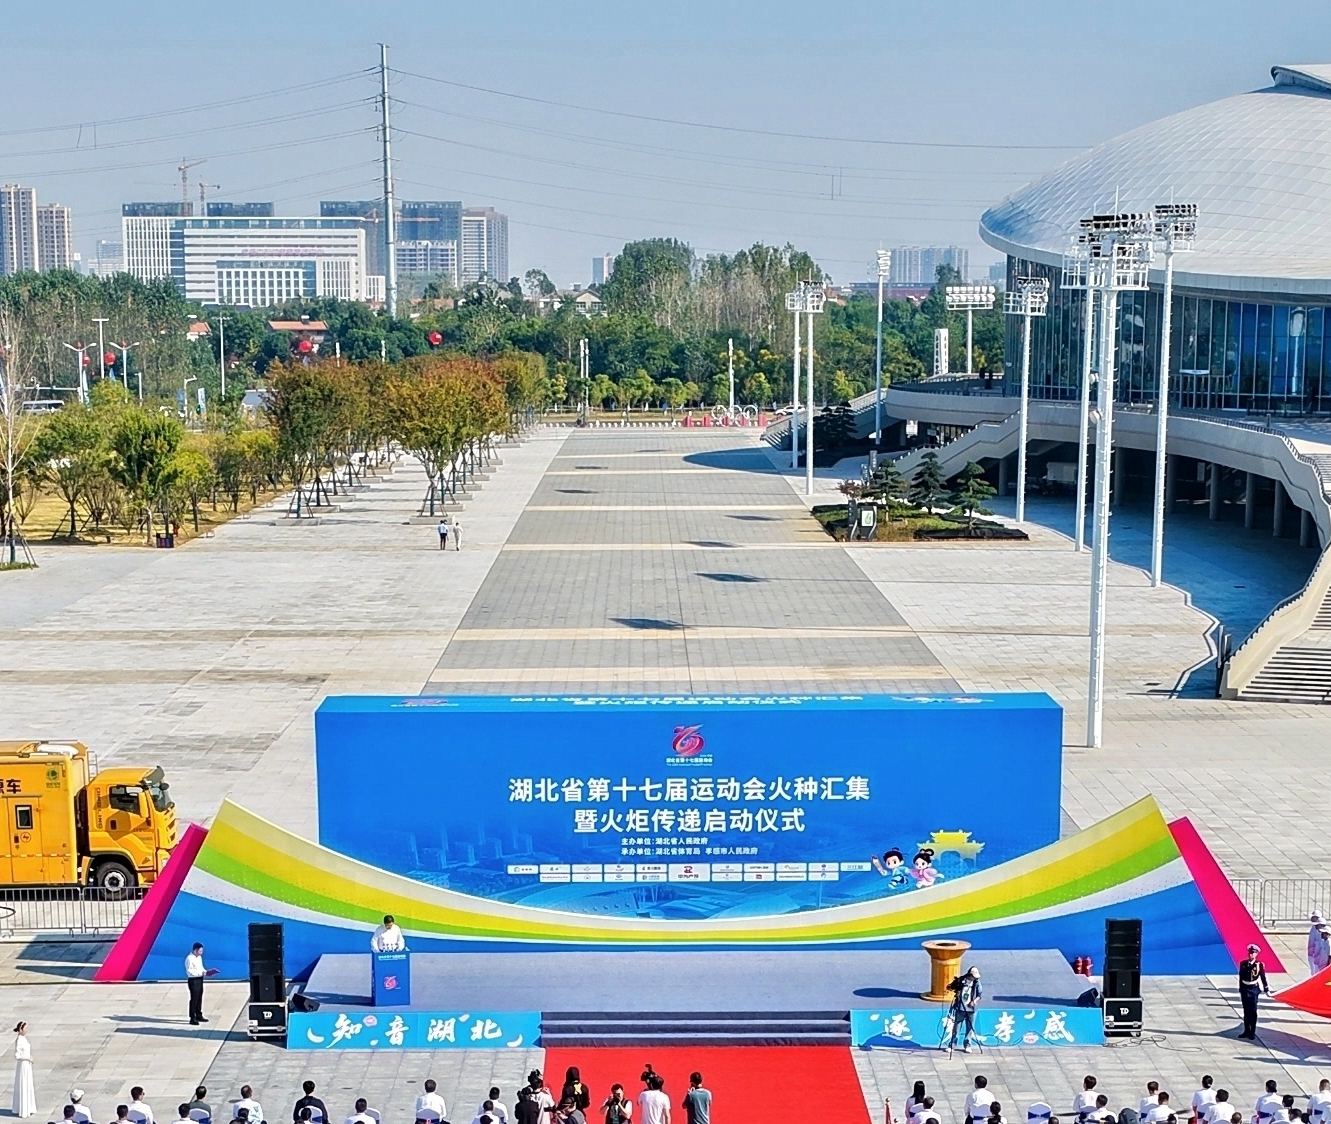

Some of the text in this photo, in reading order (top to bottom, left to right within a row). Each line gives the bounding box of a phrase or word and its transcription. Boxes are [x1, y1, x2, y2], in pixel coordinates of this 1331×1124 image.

[508, 777, 870, 803] 湖北省第十七届运动会火种汇集
[574, 808, 806, 834] 暨火炬传递启动仪式
[705, 847, 759, 856] 孝感市人民政府
[325, 1014, 503, 1048] 知音湖北
